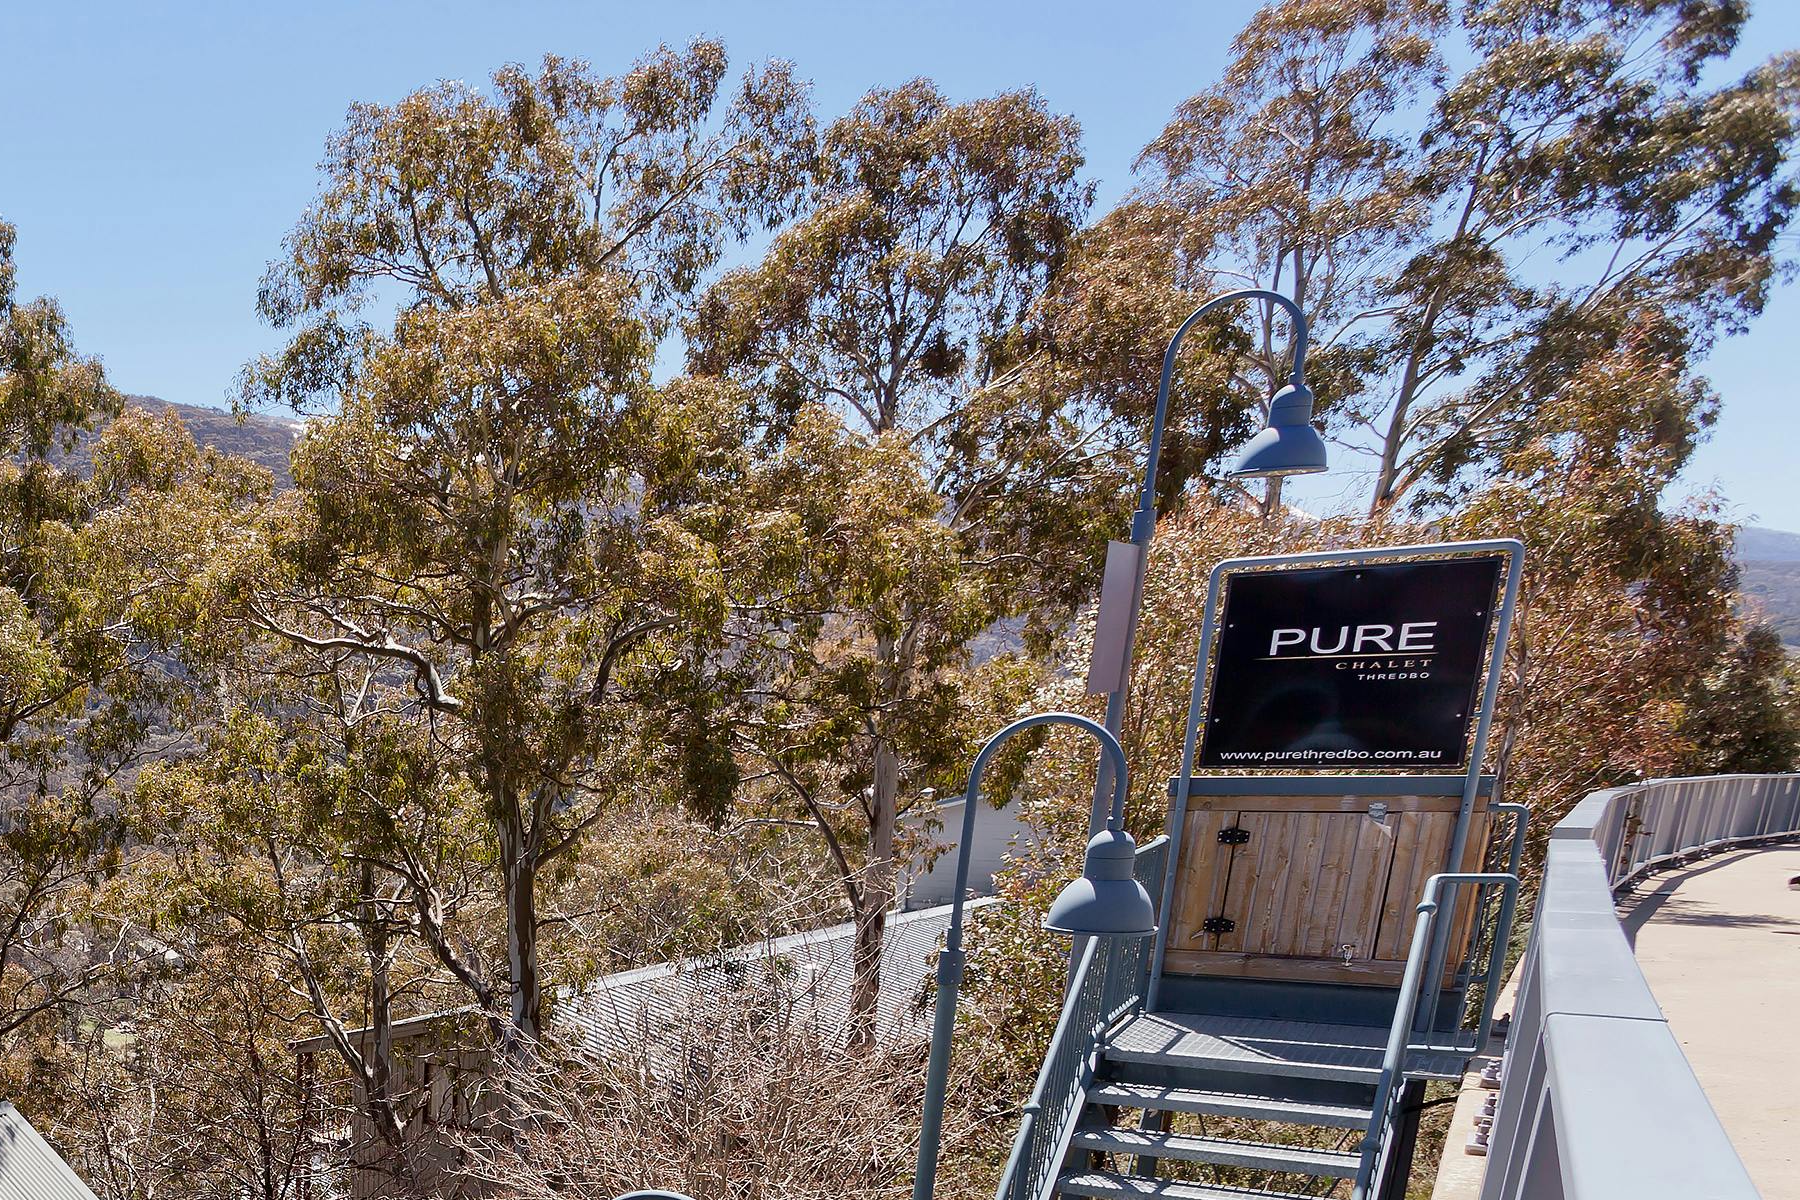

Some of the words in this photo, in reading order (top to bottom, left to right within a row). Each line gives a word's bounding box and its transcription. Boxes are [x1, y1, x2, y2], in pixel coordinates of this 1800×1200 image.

[1269, 621, 1438, 656] PURE
[1335, 659, 1433, 670] CHALET
[1357, 672, 1430, 681] THREDBO
[1220, 749, 1442, 761] www.purethredbo.com.au
